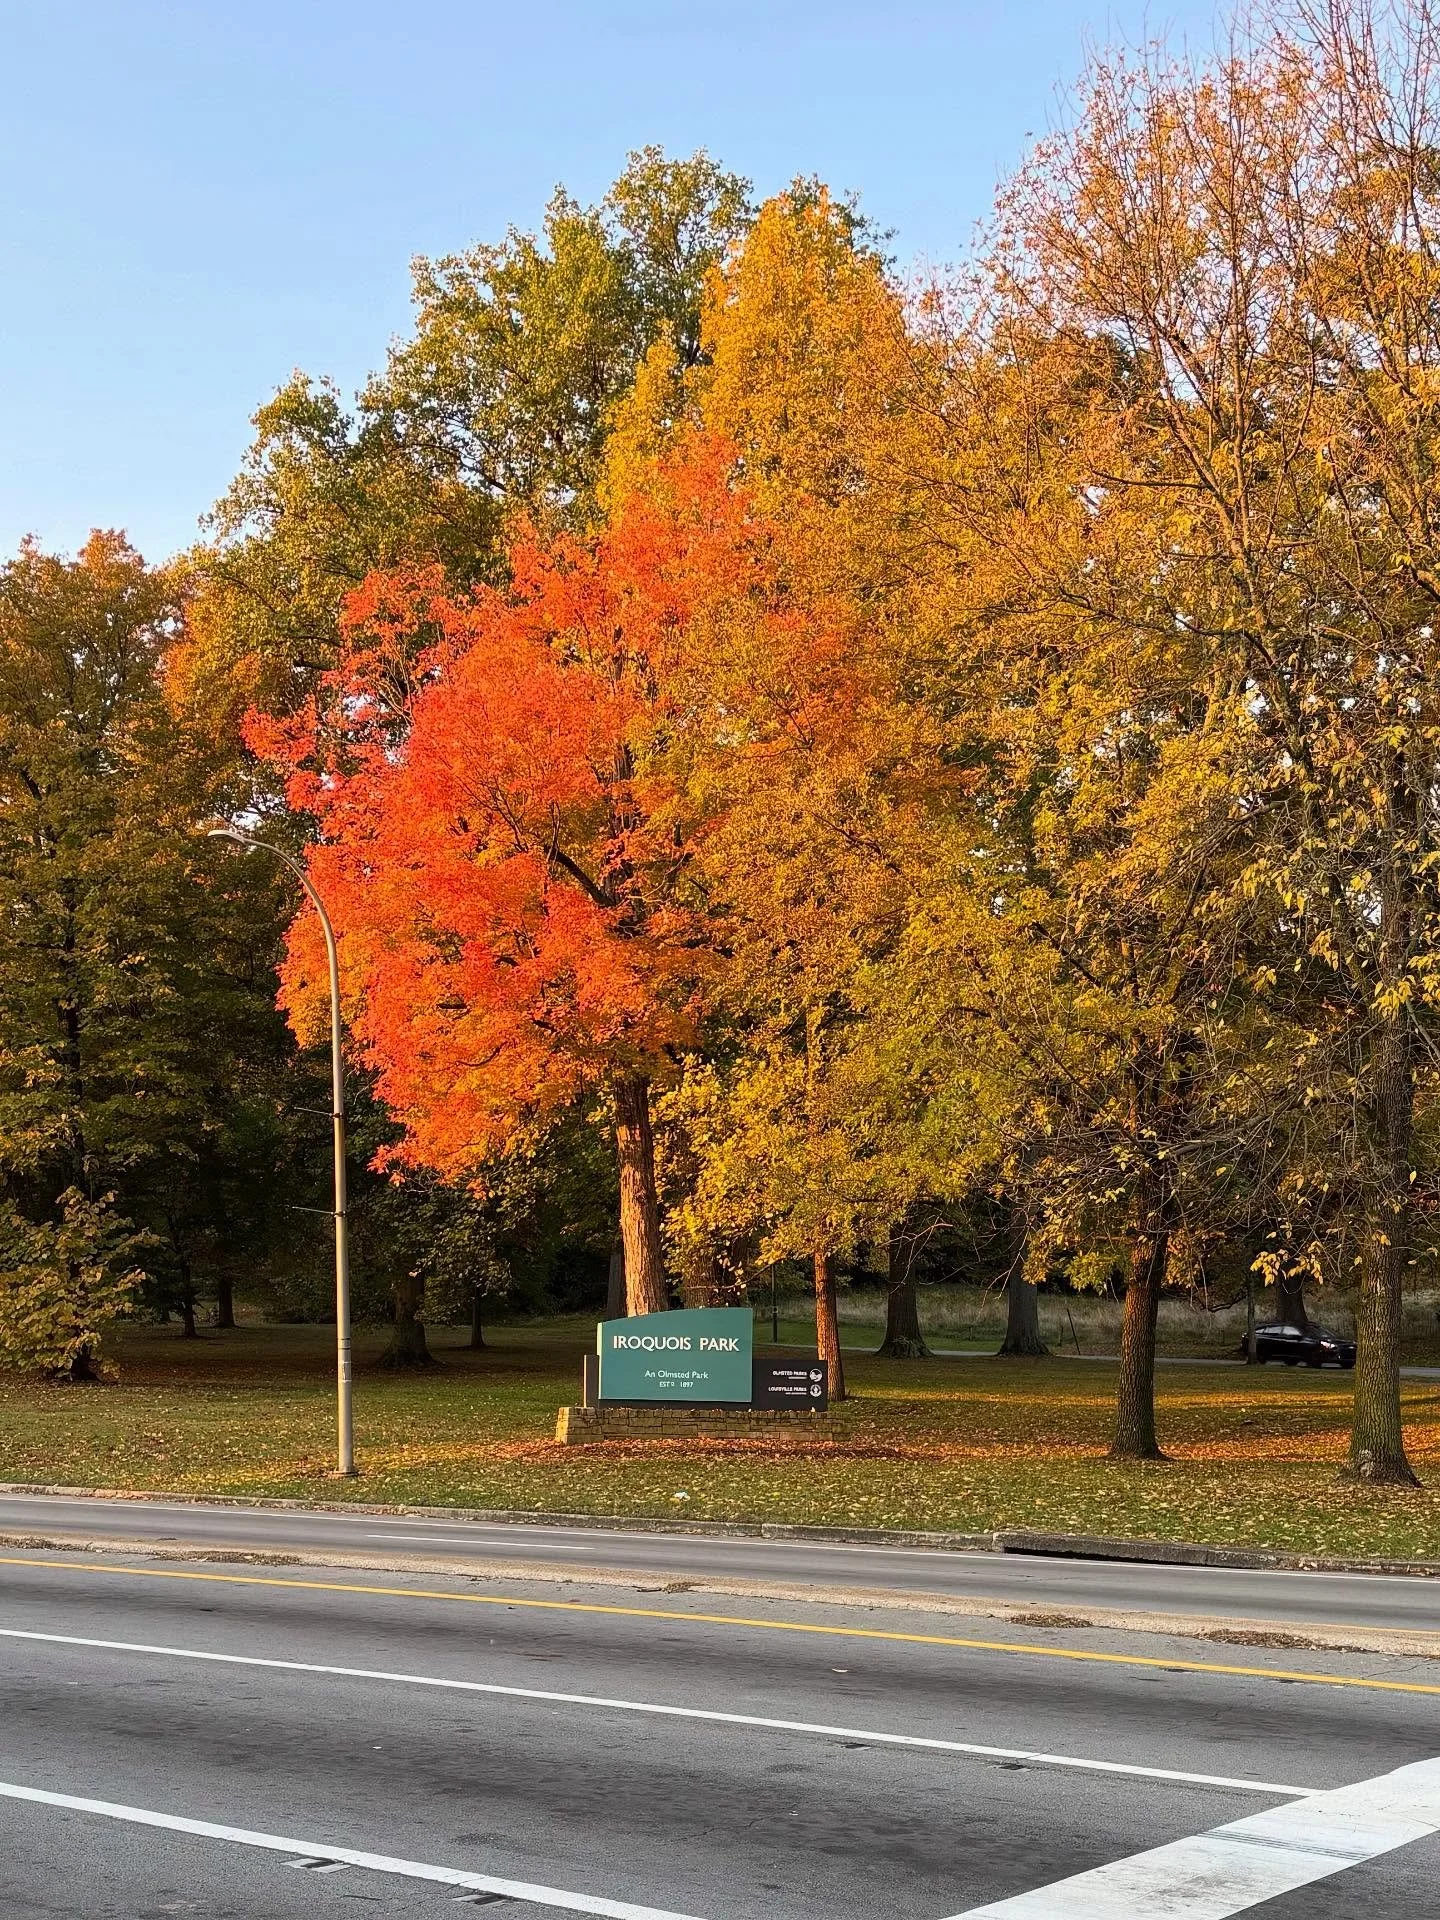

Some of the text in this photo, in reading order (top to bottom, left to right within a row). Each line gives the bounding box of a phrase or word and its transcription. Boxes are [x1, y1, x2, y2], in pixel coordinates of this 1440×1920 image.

[613, 1335, 740, 1352] IROQUOIS PARK
[644, 1370, 709, 1379] An Olmsted Park
